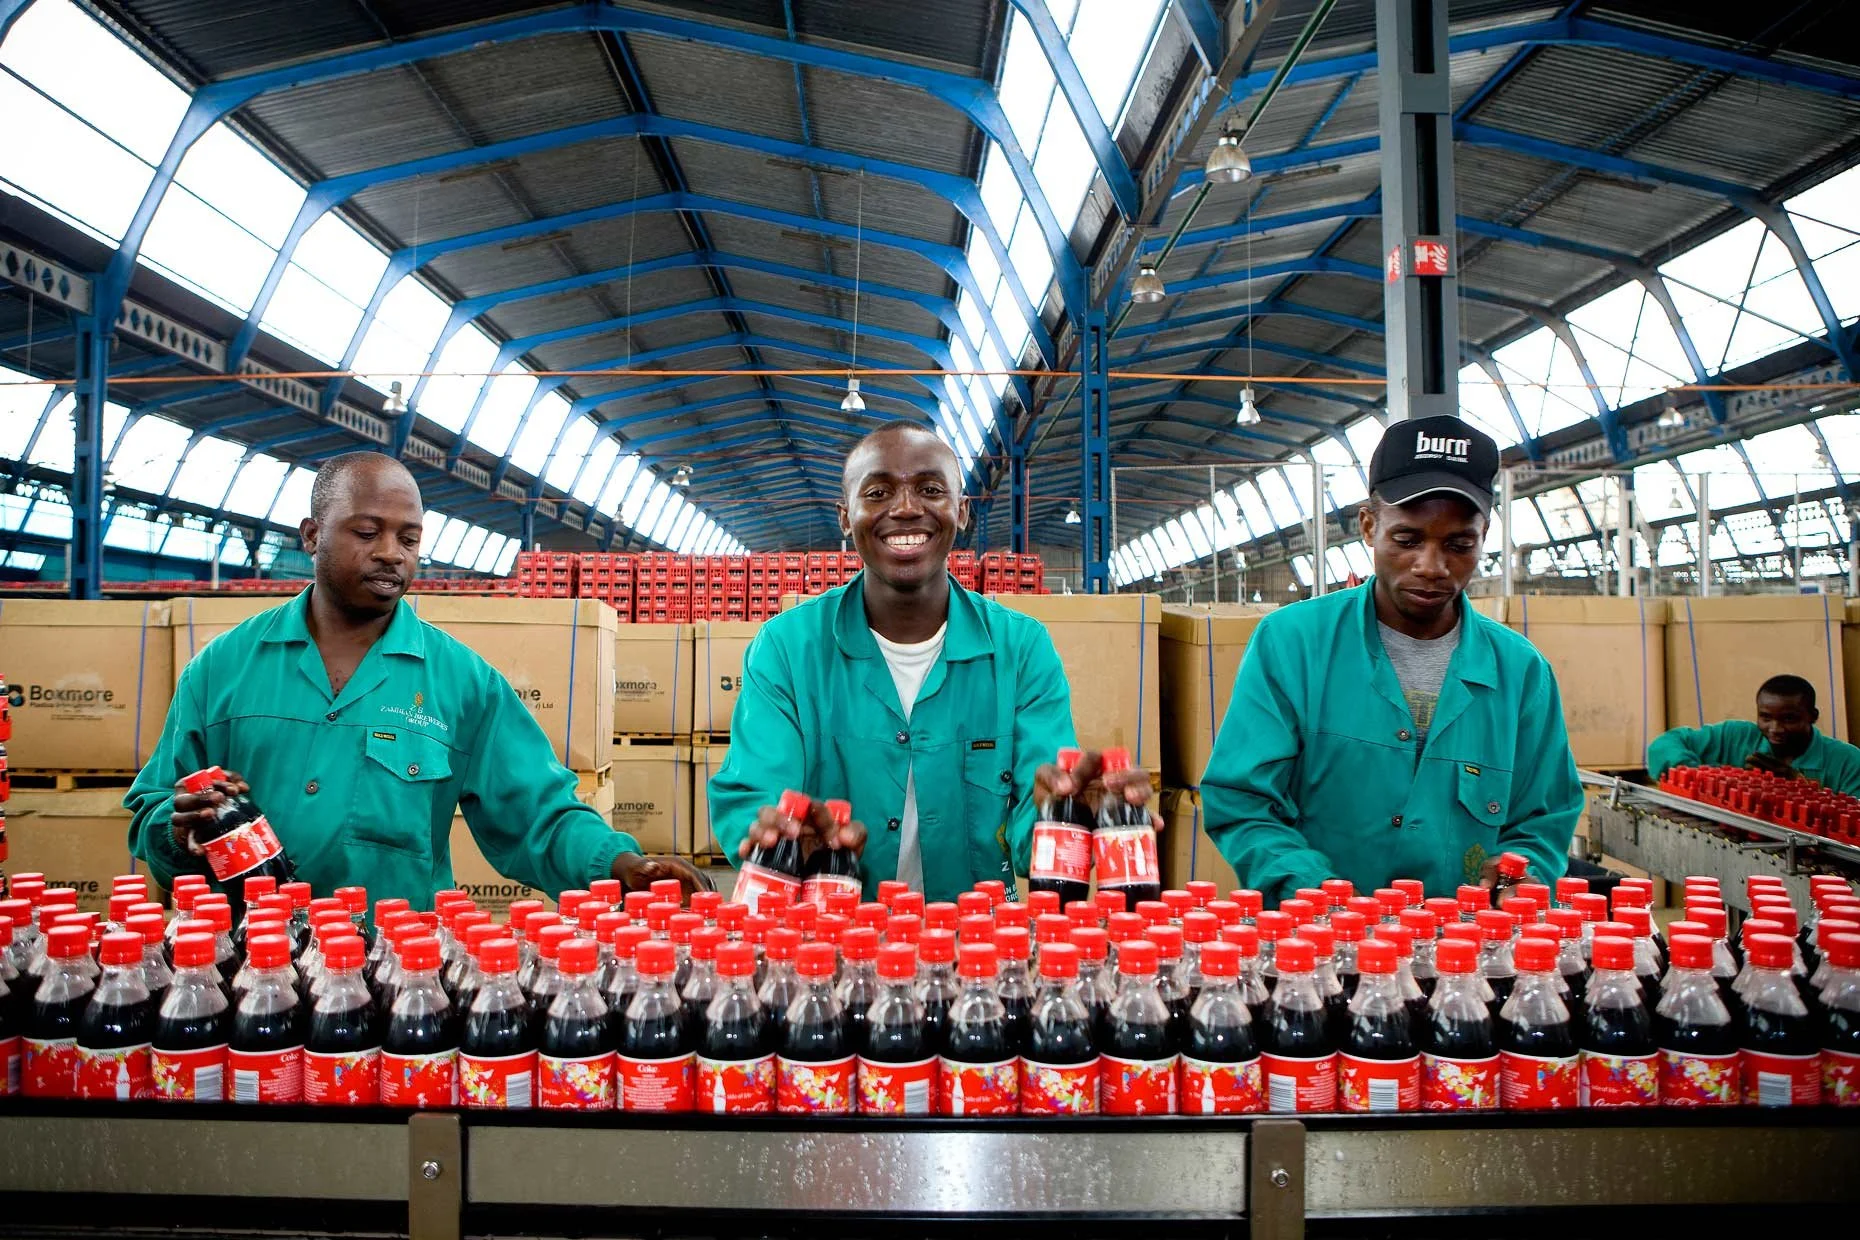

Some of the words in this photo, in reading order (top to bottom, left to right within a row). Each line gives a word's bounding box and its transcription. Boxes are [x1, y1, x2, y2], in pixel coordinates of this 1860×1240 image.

[1416, 431, 1467, 456] burn
[30, 685, 114, 702] Boxmore
[637, 1064, 658, 1073] Coke
